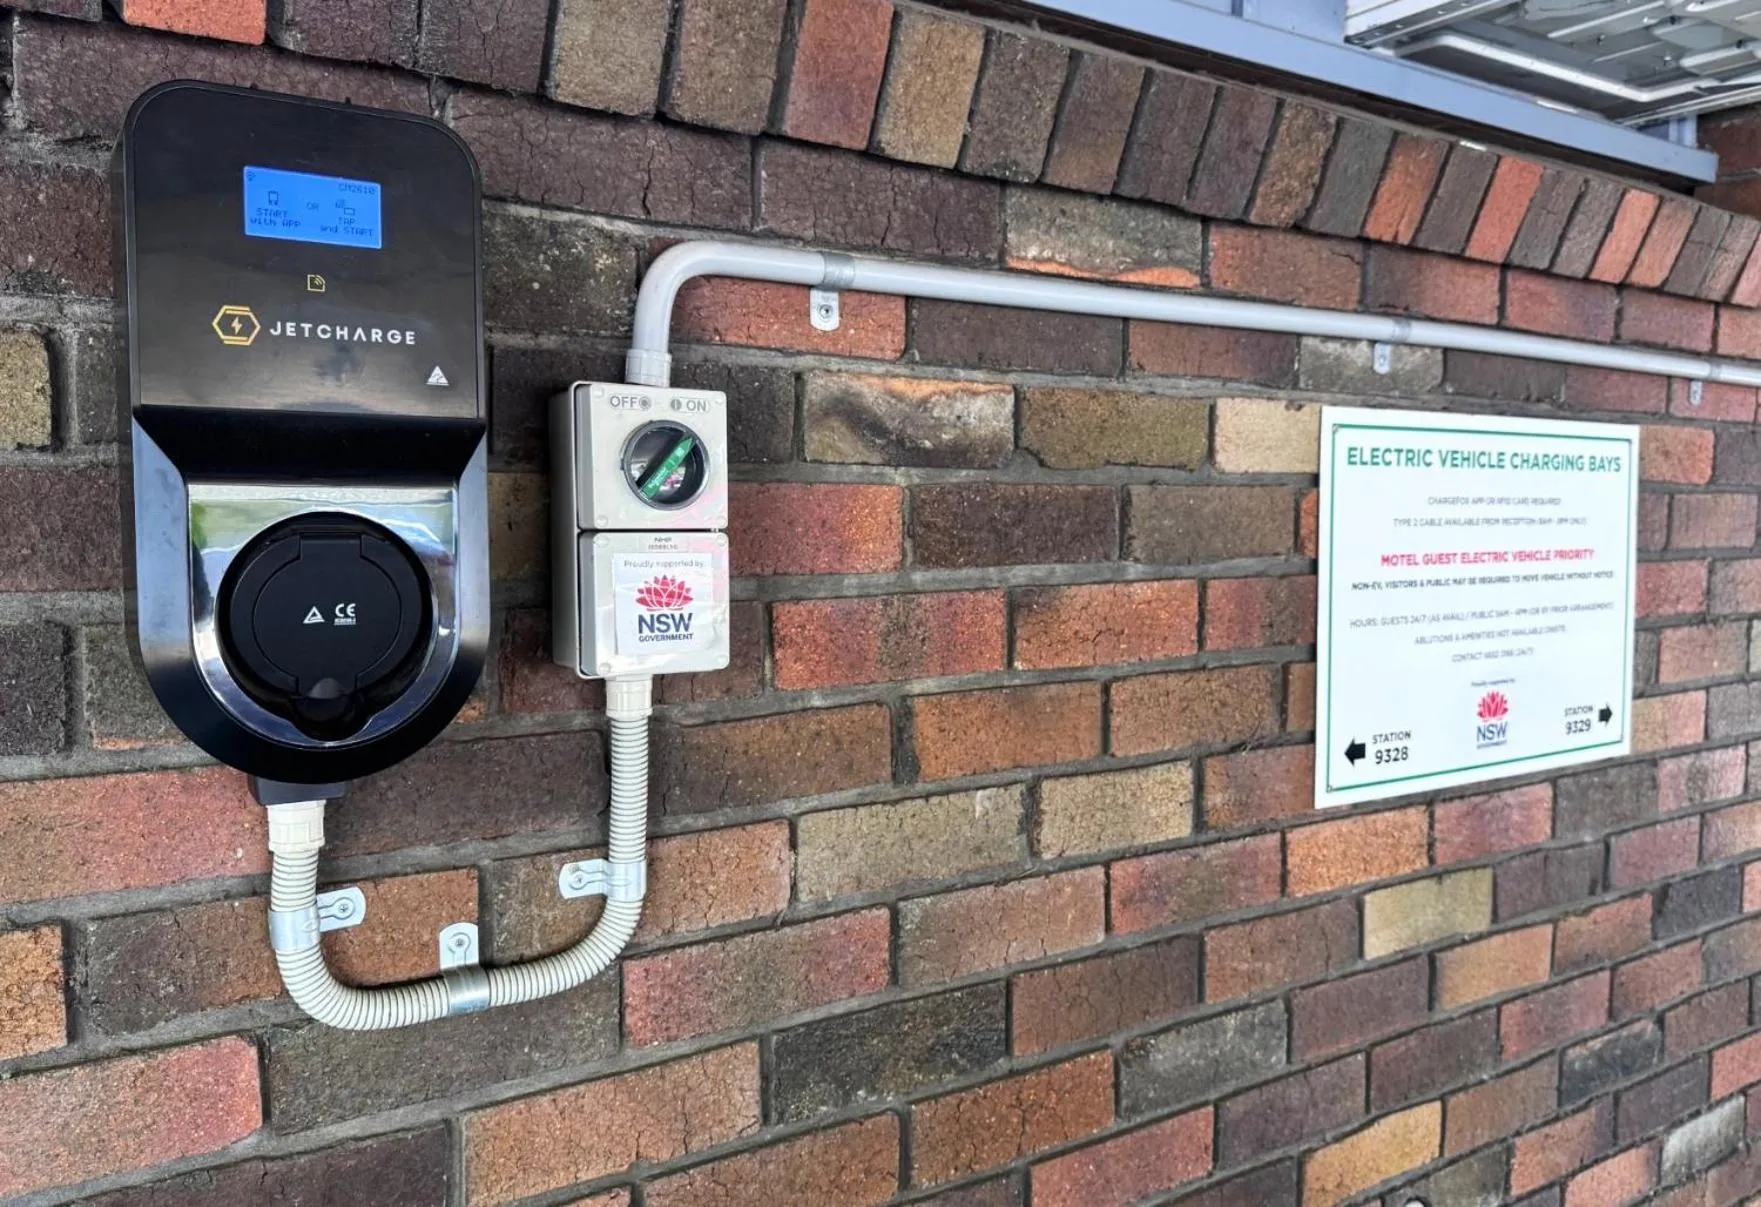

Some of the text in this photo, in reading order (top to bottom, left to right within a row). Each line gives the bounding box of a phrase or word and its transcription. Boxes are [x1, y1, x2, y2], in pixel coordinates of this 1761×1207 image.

[256, 207, 288, 218] START
[250, 217, 277, 227] with
[320, 224, 374, 238] and START
[269, 321, 417, 345] JETCHARGE
[610, 395, 638, 408] OFF
[686, 400, 707, 412] ON
[1347, 446, 1622, 472] ELECTRIC VEHICLE CHARGING BAYS
[1393, 517, 1412, 527] TYPE
[1413, 517, 1418, 527] 2
[1420, 517, 1442, 527] CABLE
[1444, 517, 1480, 526] AVAILABLE
[1481, 517, 1500, 526] FROM
[623, 559, 704, 569] Proudly supported by
[1381, 548, 1595, 567] MOTEL GUEST ELECTRIC VEHICLE PRIORITY
[1385, 580, 1418, 589] VISITORS
[1420, 579, 1424, 587] &
[1426, 578, 1451, 587] PUBLIC
[1453, 577, 1467, 586] MAY
[1468, 577, 1477, 585] BE
[1478, 575, 1511, 585] REQUIRED
[1512, 575, 1521, 583] TO
[1522, 574, 1539, 582] MOVE
[1541, 573, 1565, 581] VEHICLE
[1567, 571, 1593, 580] WITHOUT
[638, 612, 694, 634] NSW
[1381, 615, 1410, 626] GUESTS
[1411, 614, 1427, 624] 24/7
[1471, 609, 1495, 619] PUBLIC
[638, 633, 694, 643] GOVERNMENT
[1451, 651, 1483, 663] CONTACT
[1564, 704, 1594, 717] STATION
[1476, 722, 1508, 742] NSW
[1565, 718, 1592, 735] 9329
[1372, 730, 1412, 744] STATION
[1374, 746, 1409, 765] 9328
